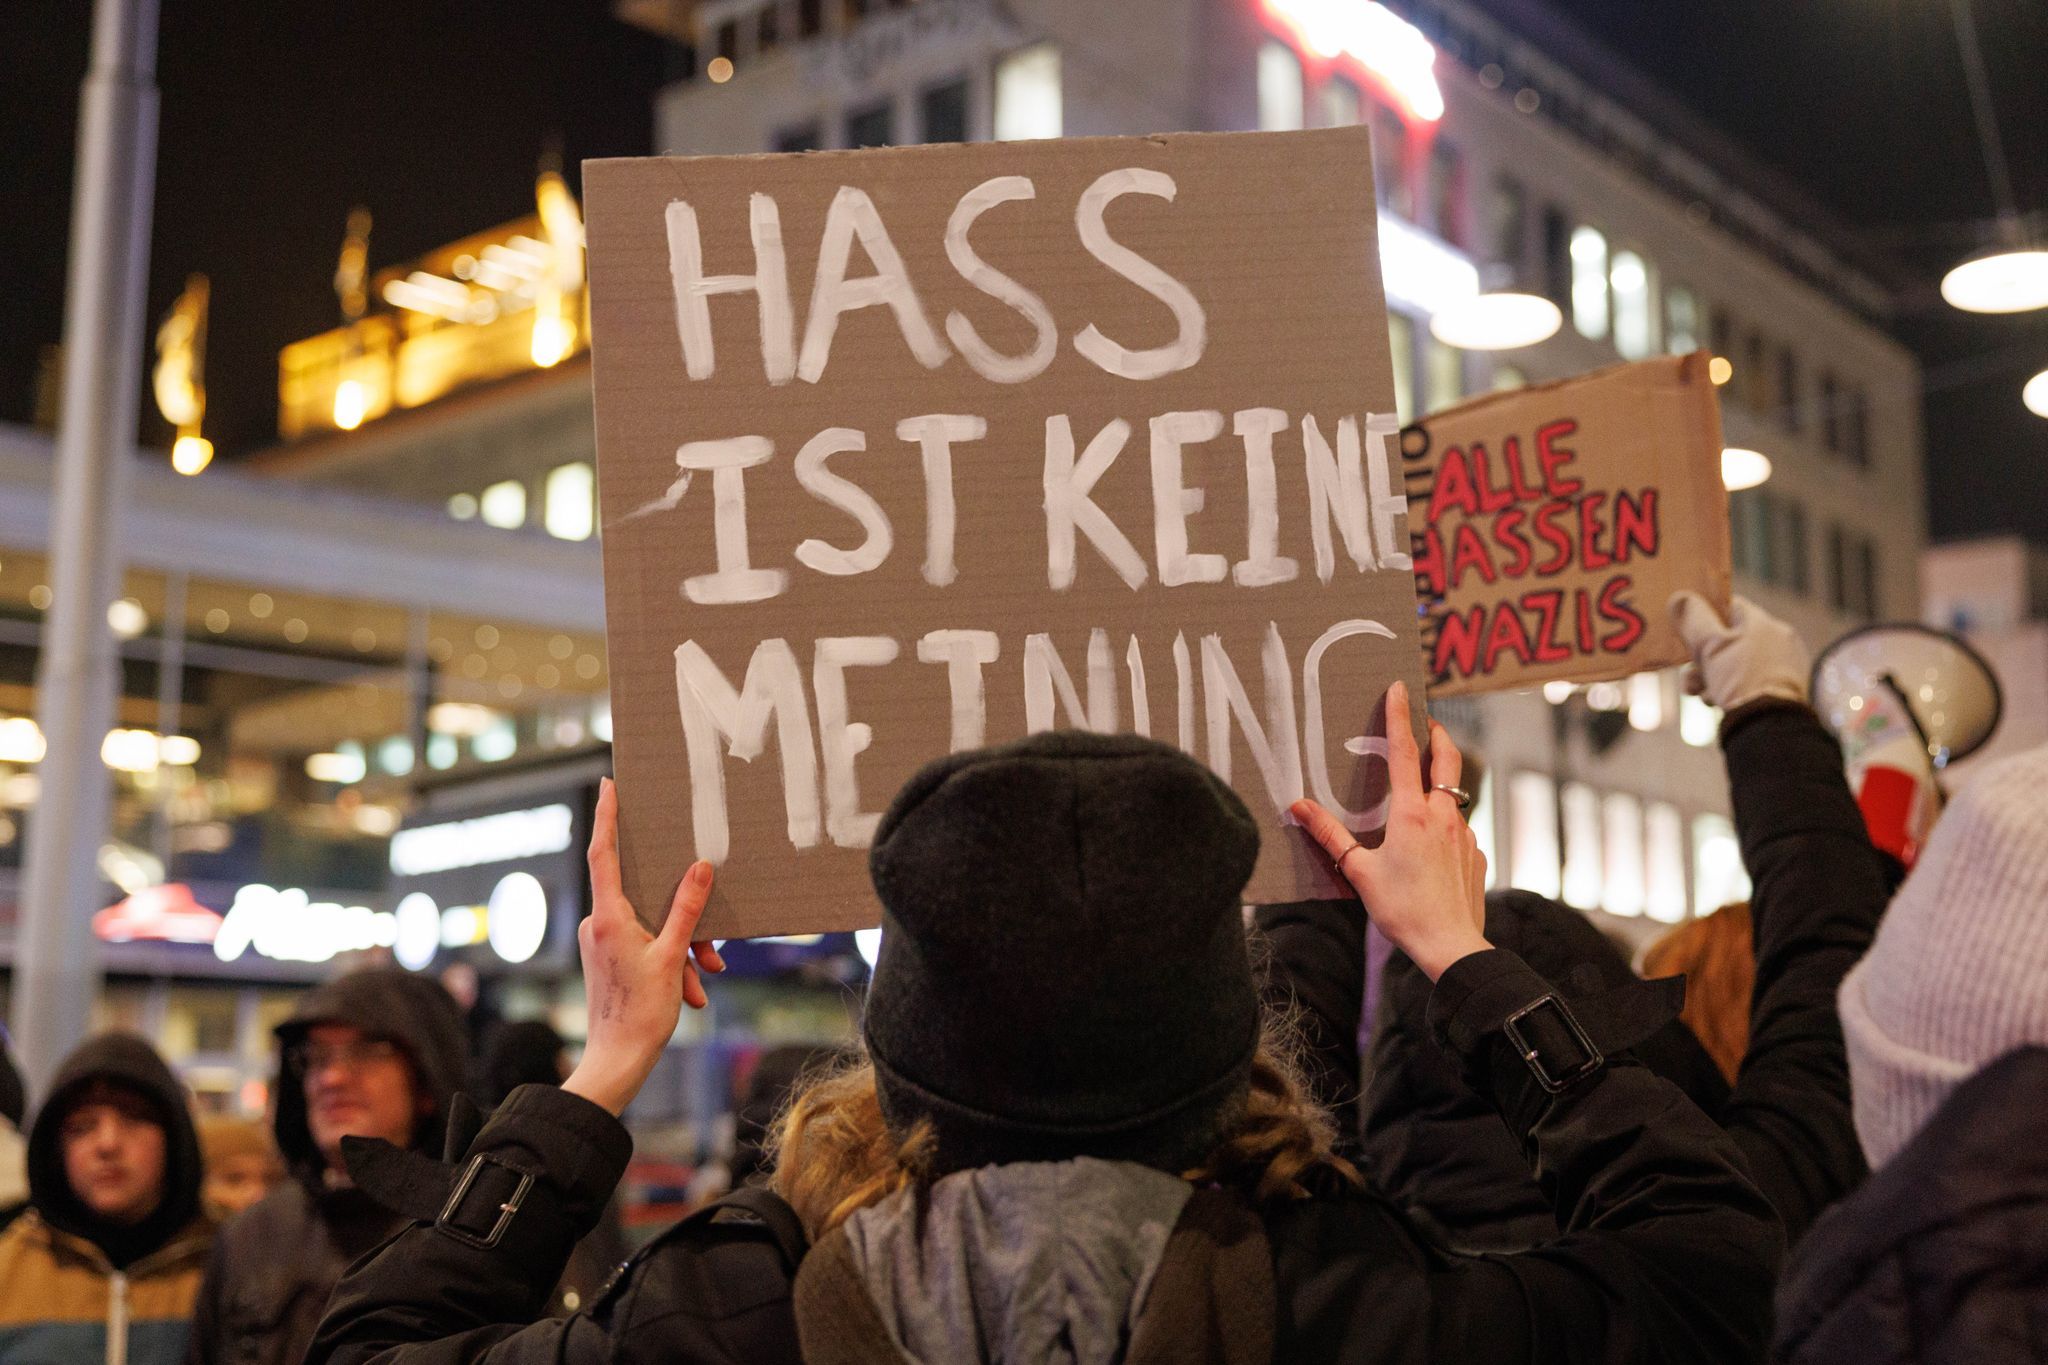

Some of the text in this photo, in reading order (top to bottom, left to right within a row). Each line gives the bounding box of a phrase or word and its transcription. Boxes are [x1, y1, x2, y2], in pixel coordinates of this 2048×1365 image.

[665, 167, 1206, 385] HASS
[676, 414, 988, 605] IST
[1043, 407, 1414, 591] KEINE
[1426, 419, 1582, 526] ALLE
[1431, 575, 1646, 679] NAZIS
